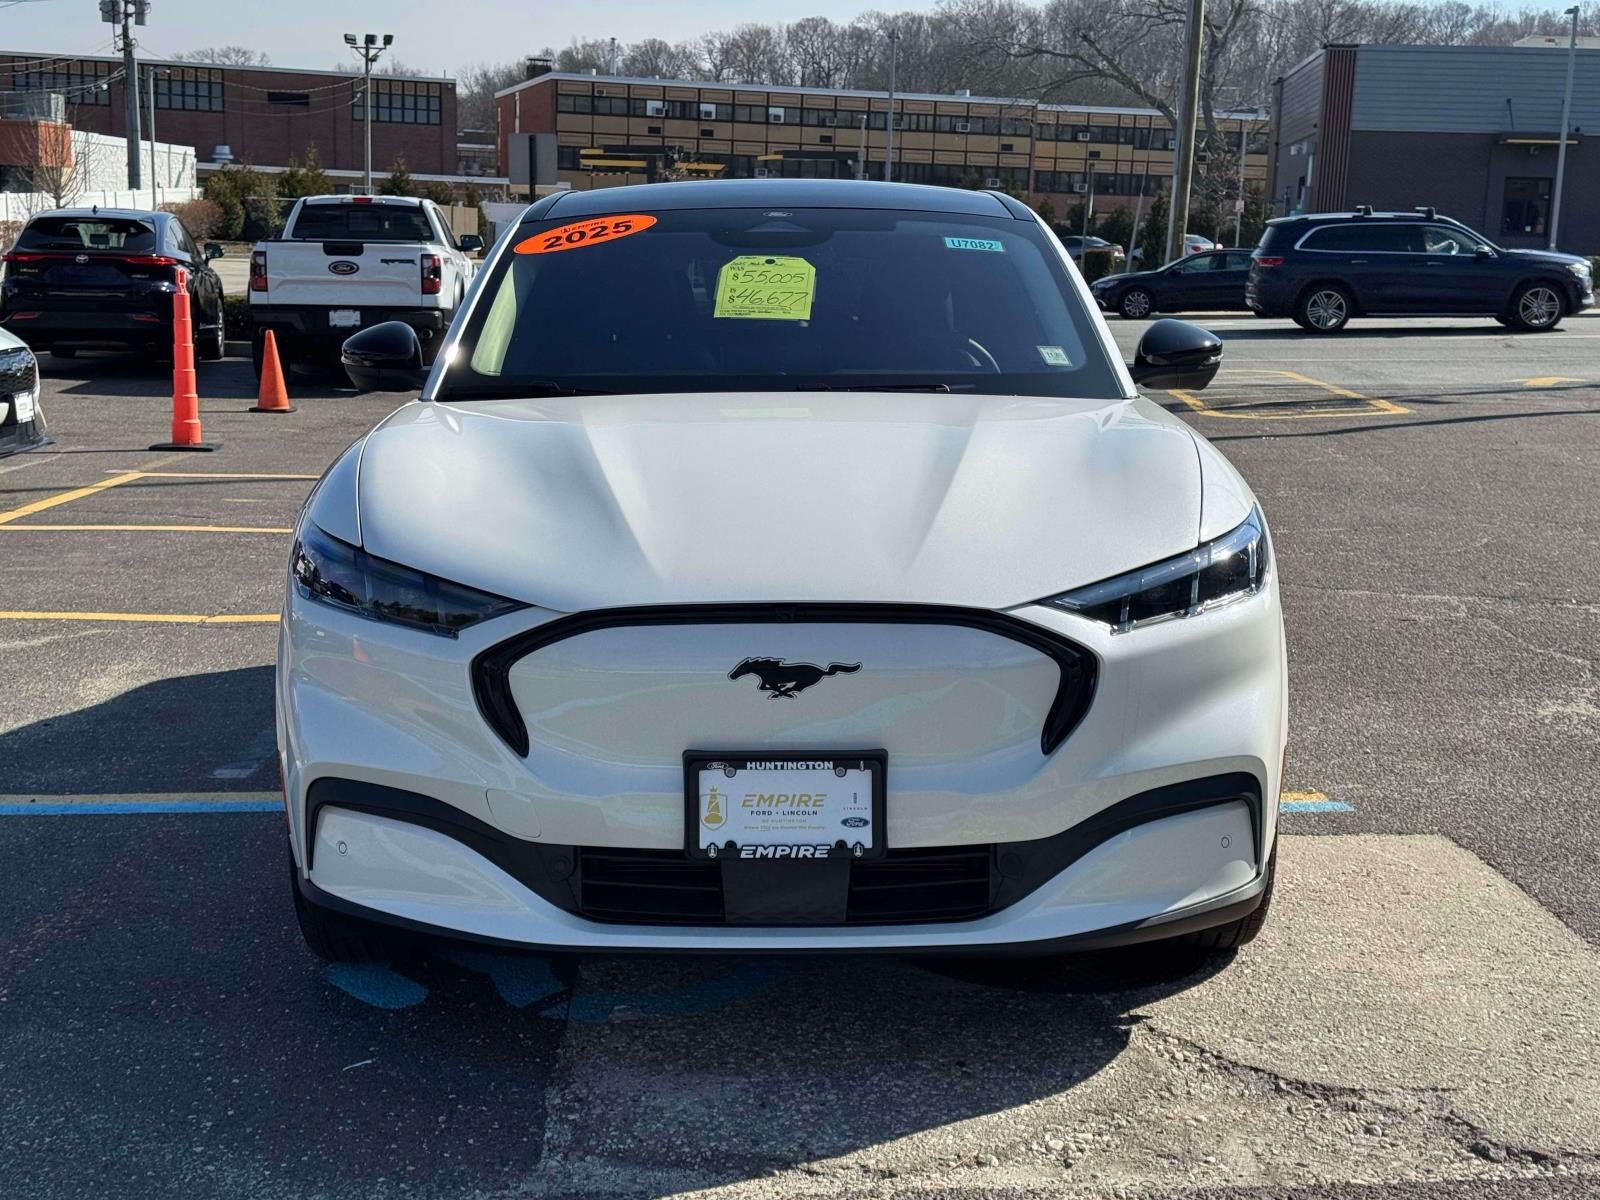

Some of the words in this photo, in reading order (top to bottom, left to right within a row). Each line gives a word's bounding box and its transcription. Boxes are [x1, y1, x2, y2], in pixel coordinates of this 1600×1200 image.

[543, 220, 632, 250] 2025
[951, 239, 993, 249] U7082
[746, 761, 834, 770] HUNTINGTON
[741, 793, 827, 808] EMPIRE
[740, 845, 831, 859] EMPIRE
